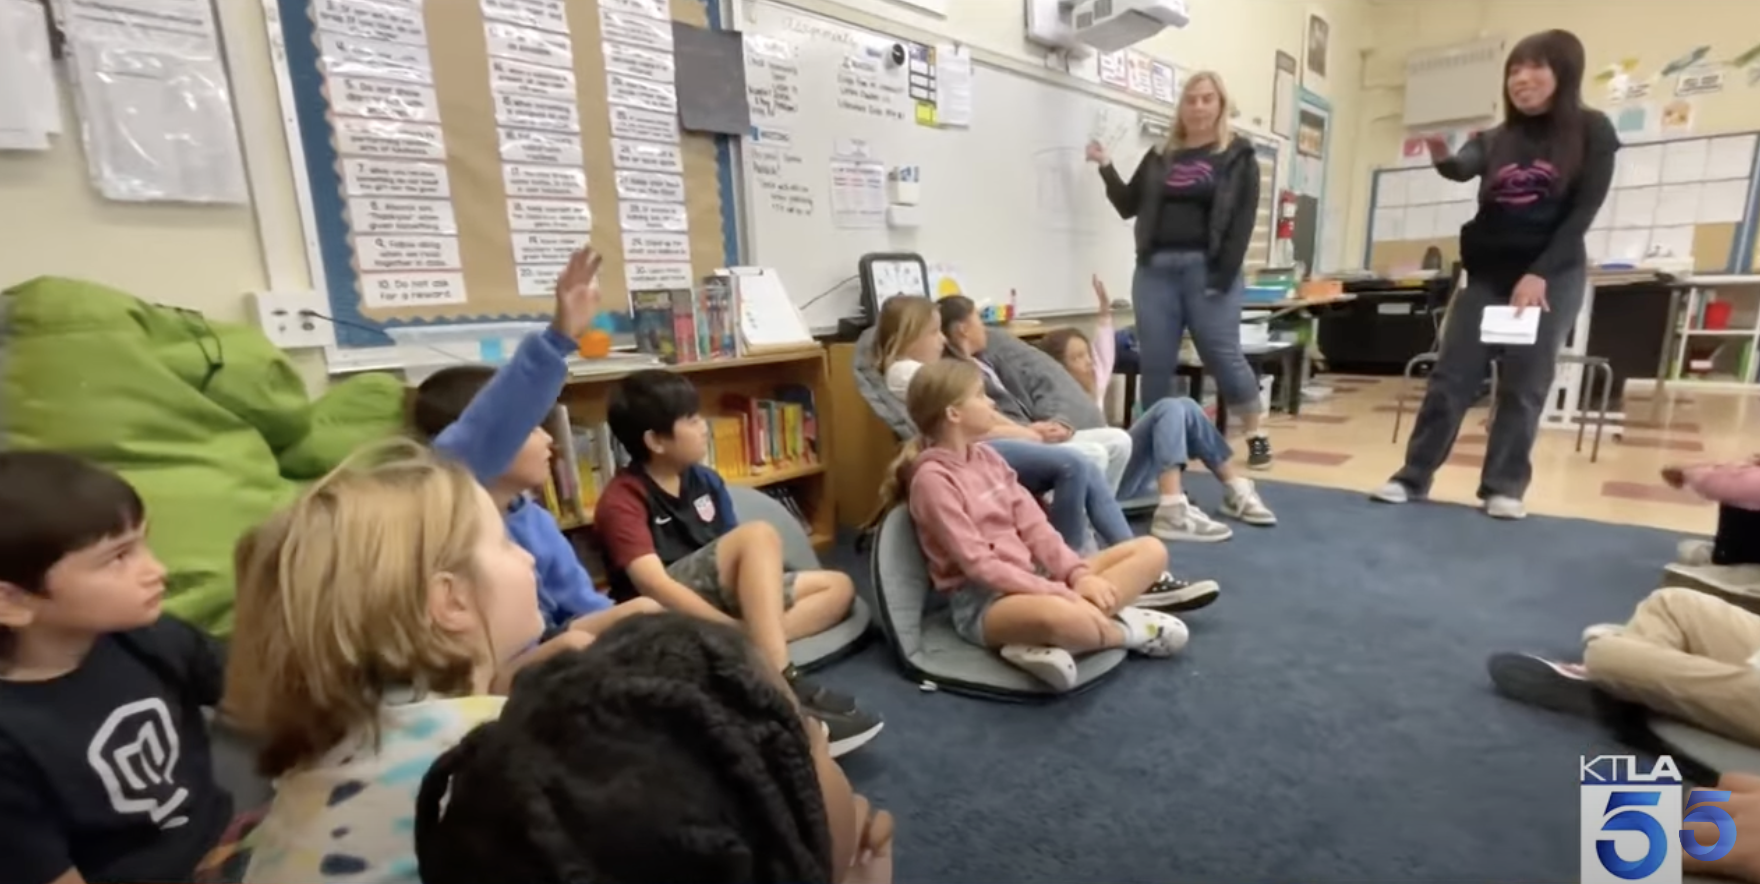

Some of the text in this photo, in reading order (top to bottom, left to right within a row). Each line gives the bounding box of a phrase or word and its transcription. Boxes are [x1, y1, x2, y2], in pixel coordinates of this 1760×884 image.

[394, 279, 409, 289] Do
[411, 280, 429, 288] not
[379, 291, 399, 300] for
